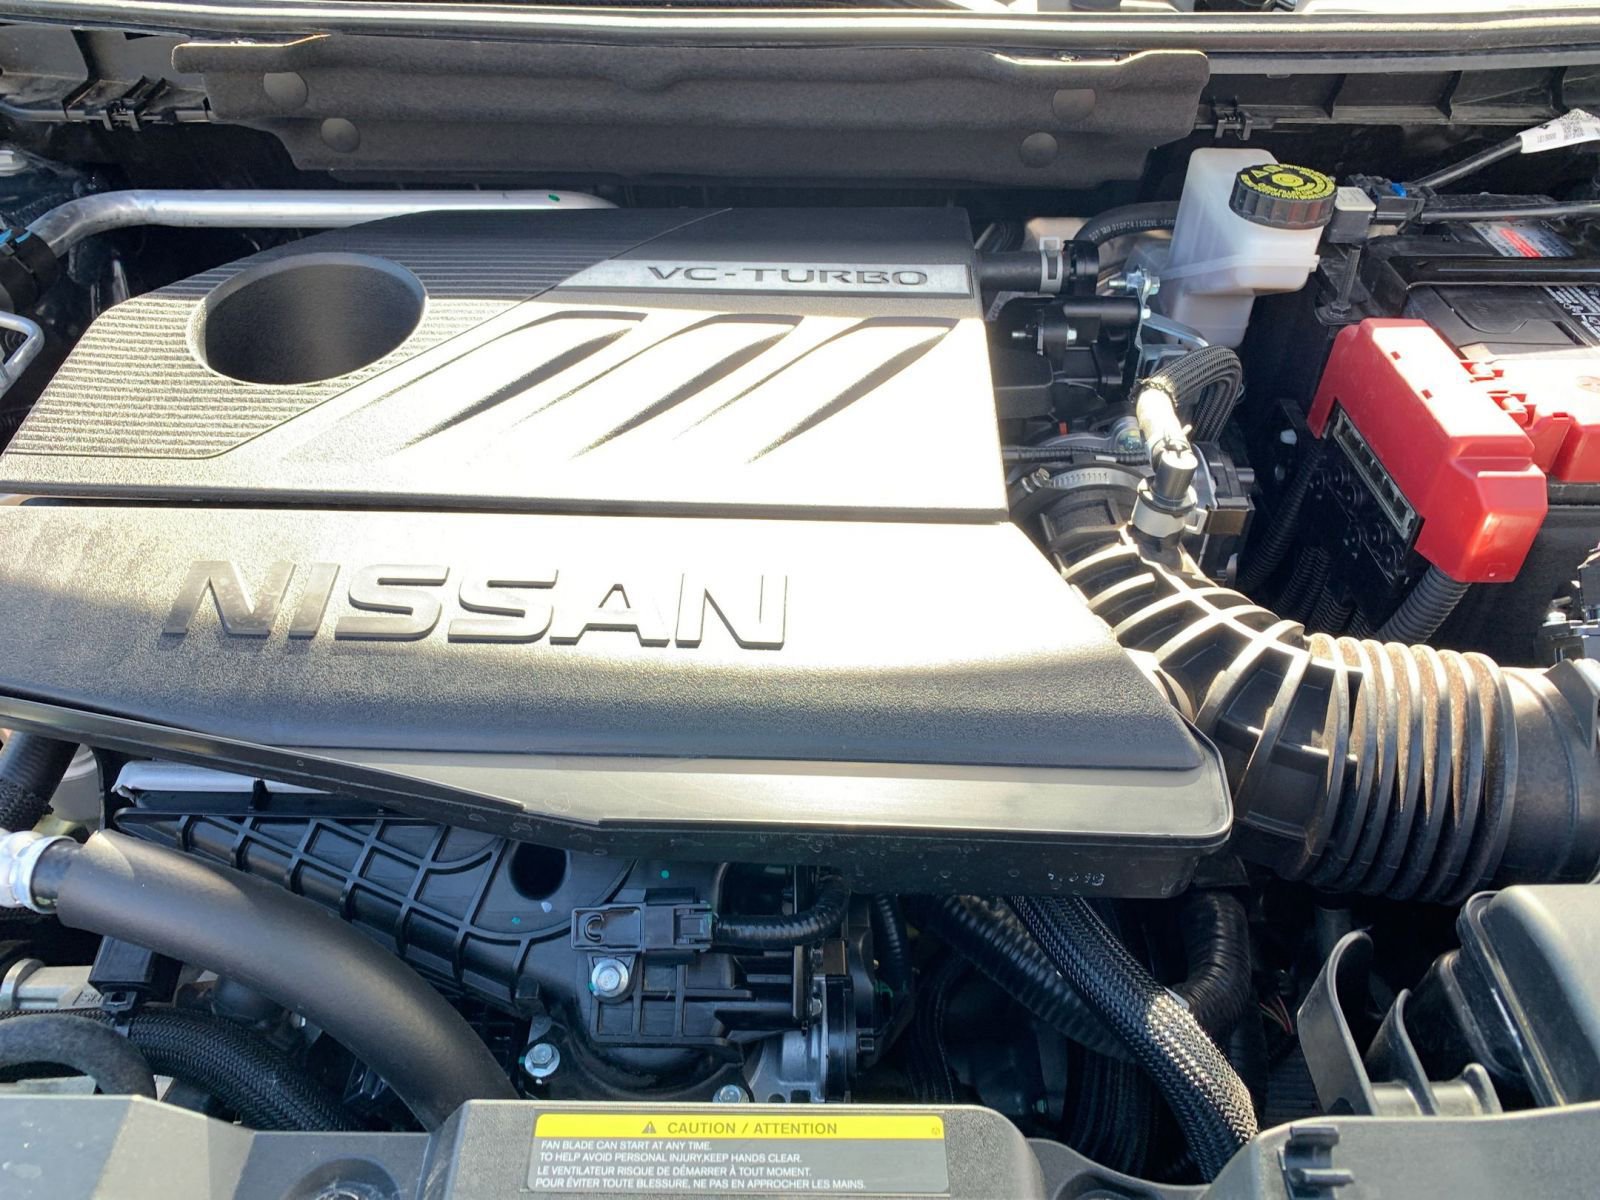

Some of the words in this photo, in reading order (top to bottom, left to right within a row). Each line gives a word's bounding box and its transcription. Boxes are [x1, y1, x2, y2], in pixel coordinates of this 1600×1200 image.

[647, 266, 928, 286] VC-TURBO
[161, 560, 788, 650] NISSAN
[667, 1122, 736, 1134] CAUTION
[753, 1122, 838, 1134] ATTENTION
[541, 1141, 560, 1151] FAN
[562, 1141, 593, 1151] BLADE
[596, 1141, 618, 1151] CAN
[620, 1141, 650, 1151] START
[652, 1141, 664, 1151] AT
[665, 1141, 685, 1151] ANY
[688, 1141, 712, 1151] TIME.
[540, 1153, 553, 1163] TO
[555, 1153, 581, 1163] HELP
[582, 1153, 612, 1163] AVOID
[614, 1153, 667, 1163] PERSONAL
[731, 1153, 766, 1163] HANDS
[768, 1153, 802, 1163] CLEAR.
[537, 1166, 549, 1176] LE
[551, 1166, 615, 1176] VENTILATEUR
[618, 1166, 654, 1176] RISQUE
[656, 1166, 670, 1176] DE
[672, 1165, 727, 1176] DÉMARRER
[739, 1166, 764, 1176] TOUT
[766, 1166, 811, 1176] MOMENT.
[535, 1178, 564, 1189] POUR
[566, 1177, 600, 1189] ÉVITER
[602, 1178, 634, 1189] TOUTE
[693, 1178, 707, 1189] NE
[709, 1178, 729, 1189] PAS
[731, 1178, 745, 1189] EN
[747, 1178, 809, 1189] APPROCHER
[811, 1178, 830, 1189] LES
[832, 1178, 866, 1189] MAINS.
